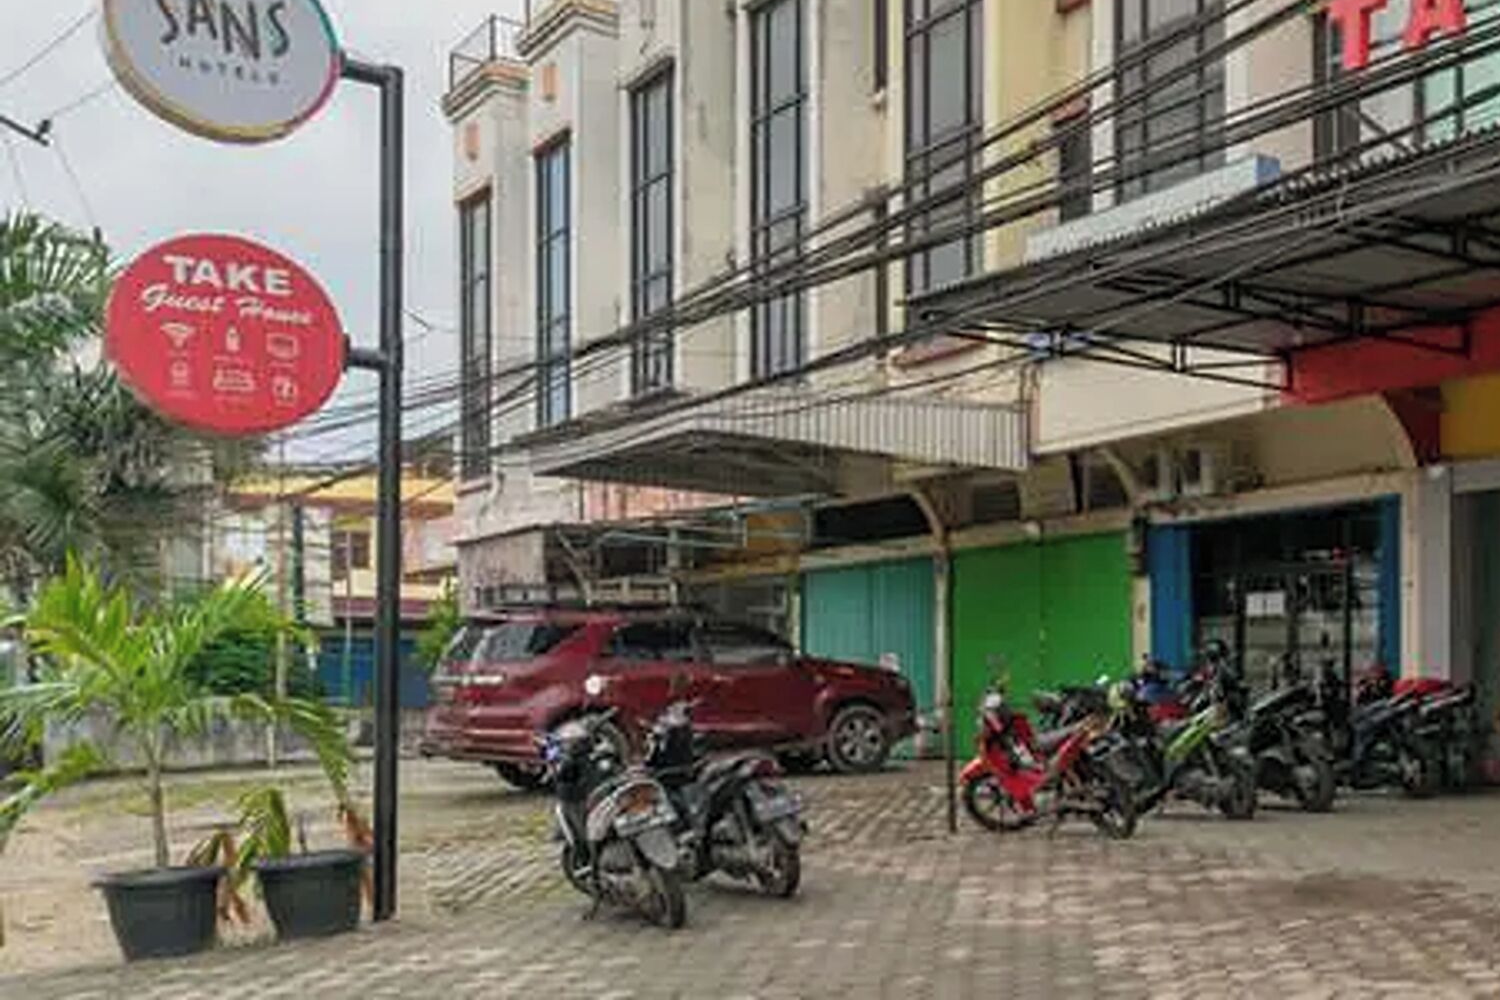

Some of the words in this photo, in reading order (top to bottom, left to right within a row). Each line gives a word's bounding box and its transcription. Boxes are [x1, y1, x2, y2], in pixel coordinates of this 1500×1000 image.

[179, 56, 280, 86] HOTELS
[163, 253, 295, 297] TAKE
[140, 283, 225, 314] Guest
[238, 296, 314, 327] House
